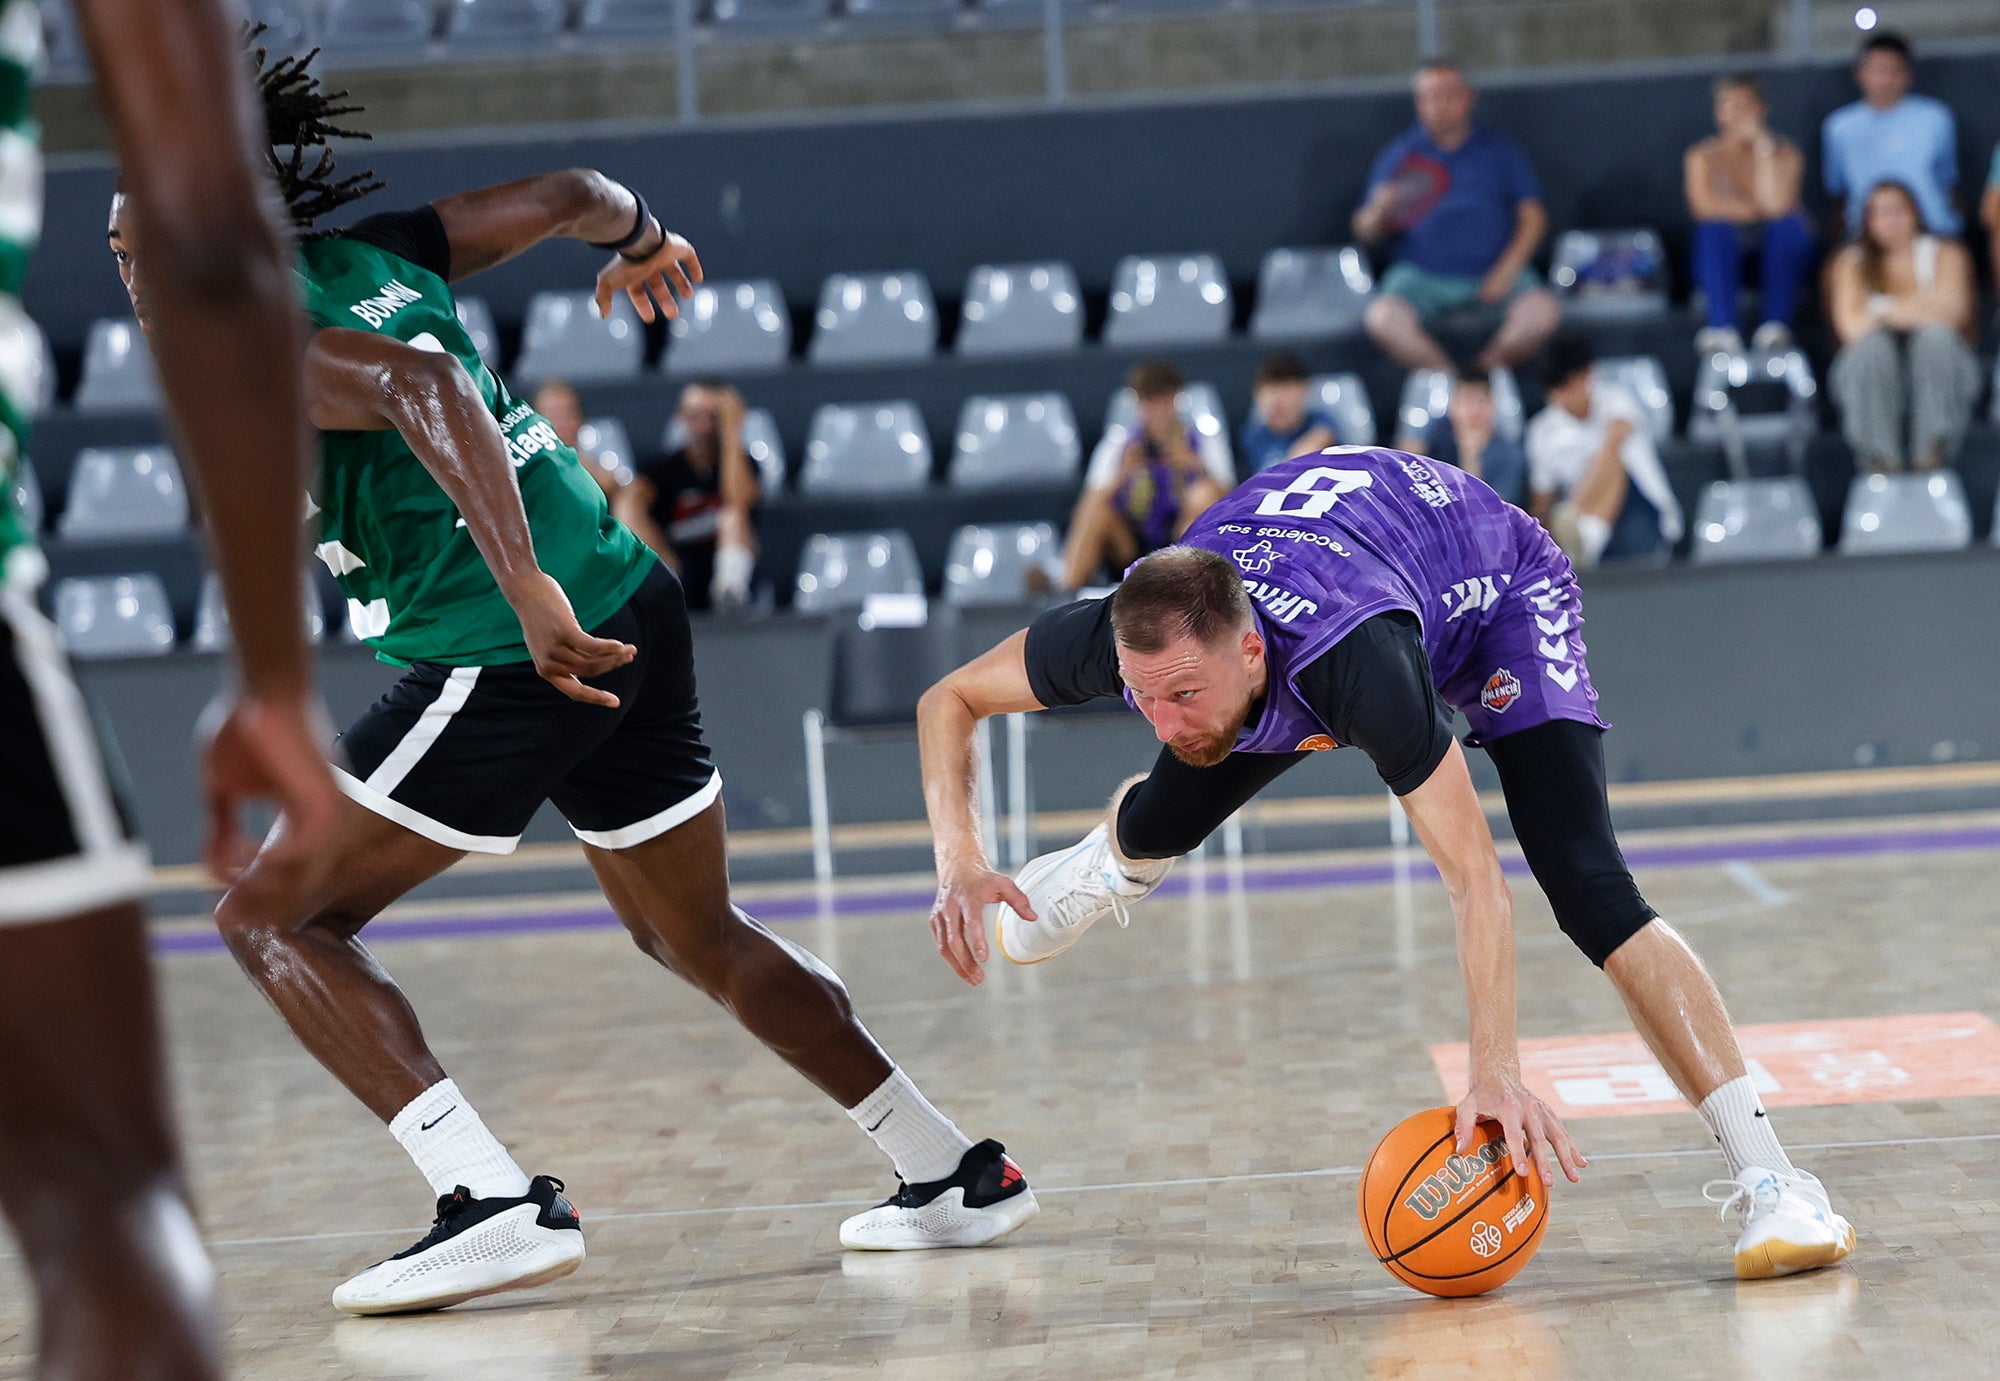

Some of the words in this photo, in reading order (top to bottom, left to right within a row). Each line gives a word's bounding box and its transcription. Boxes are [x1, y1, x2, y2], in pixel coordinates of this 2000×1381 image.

[504, 421, 559, 467] tiago
[1256, 527, 1352, 557] recoletas
[1501, 1193, 1531, 1224] PRIMERA
[1504, 1198, 1536, 1234] FEB
